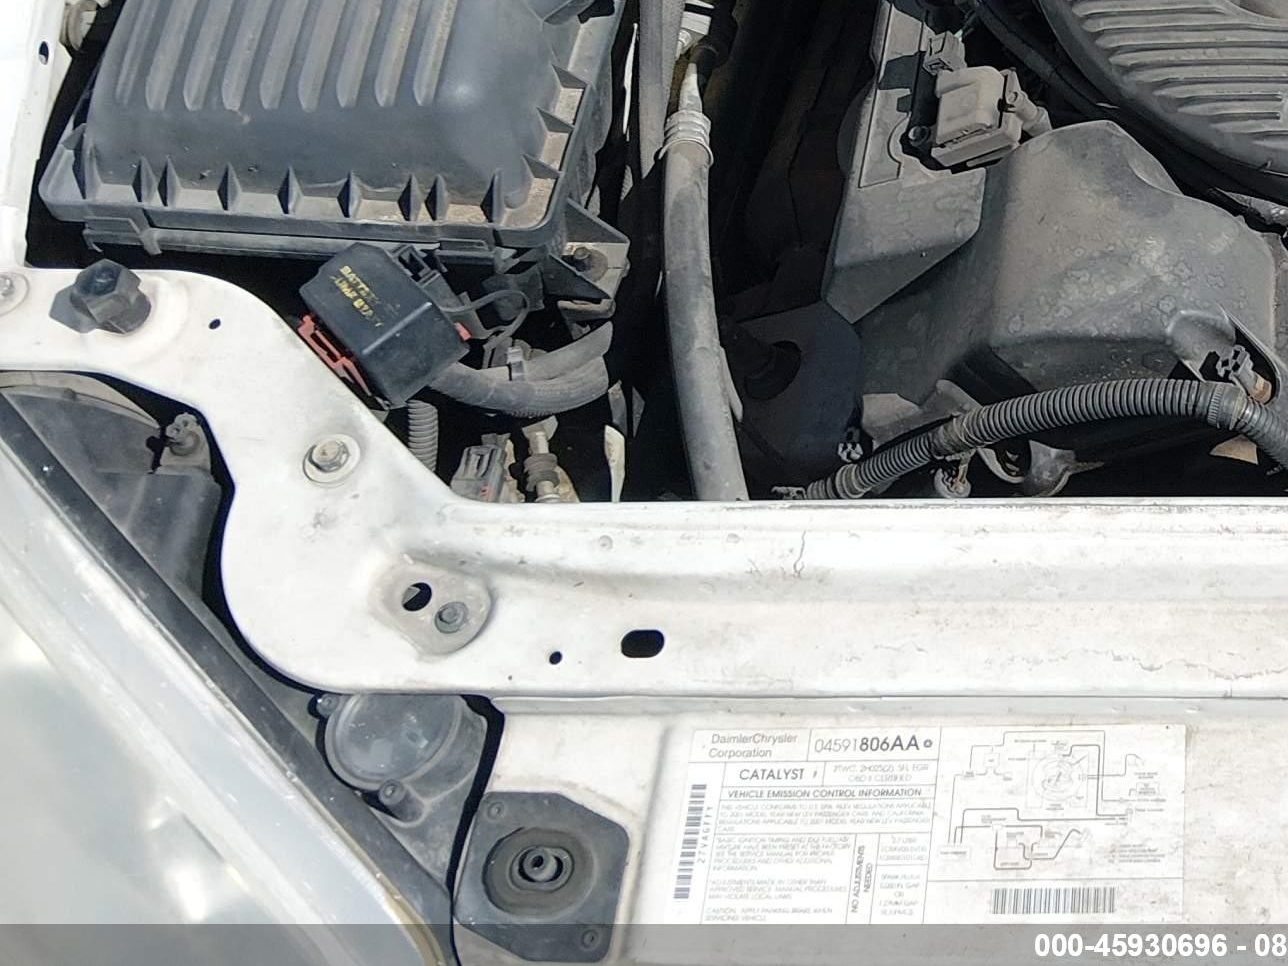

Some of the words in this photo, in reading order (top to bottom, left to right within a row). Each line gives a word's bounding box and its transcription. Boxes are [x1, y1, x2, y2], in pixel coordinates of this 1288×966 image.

[711, 733, 799, 746] DaimlerChrysler
[814, 734, 920, 753] 04591806AA
[709, 747, 772, 760] Corporation
[739, 768, 806, 780] CATALYST
[728, 790, 764, 798] VEHICLE
[767, 790, 811, 798] EMISSION
[813, 789, 857, 797] CONTROL
[859, 788, 922, 796] INFORMATION
[853, 844, 866, 898] ADJUSTMENTS
[863, 862, 873, 893] NEEDED
[851, 899, 860, 914] NO
